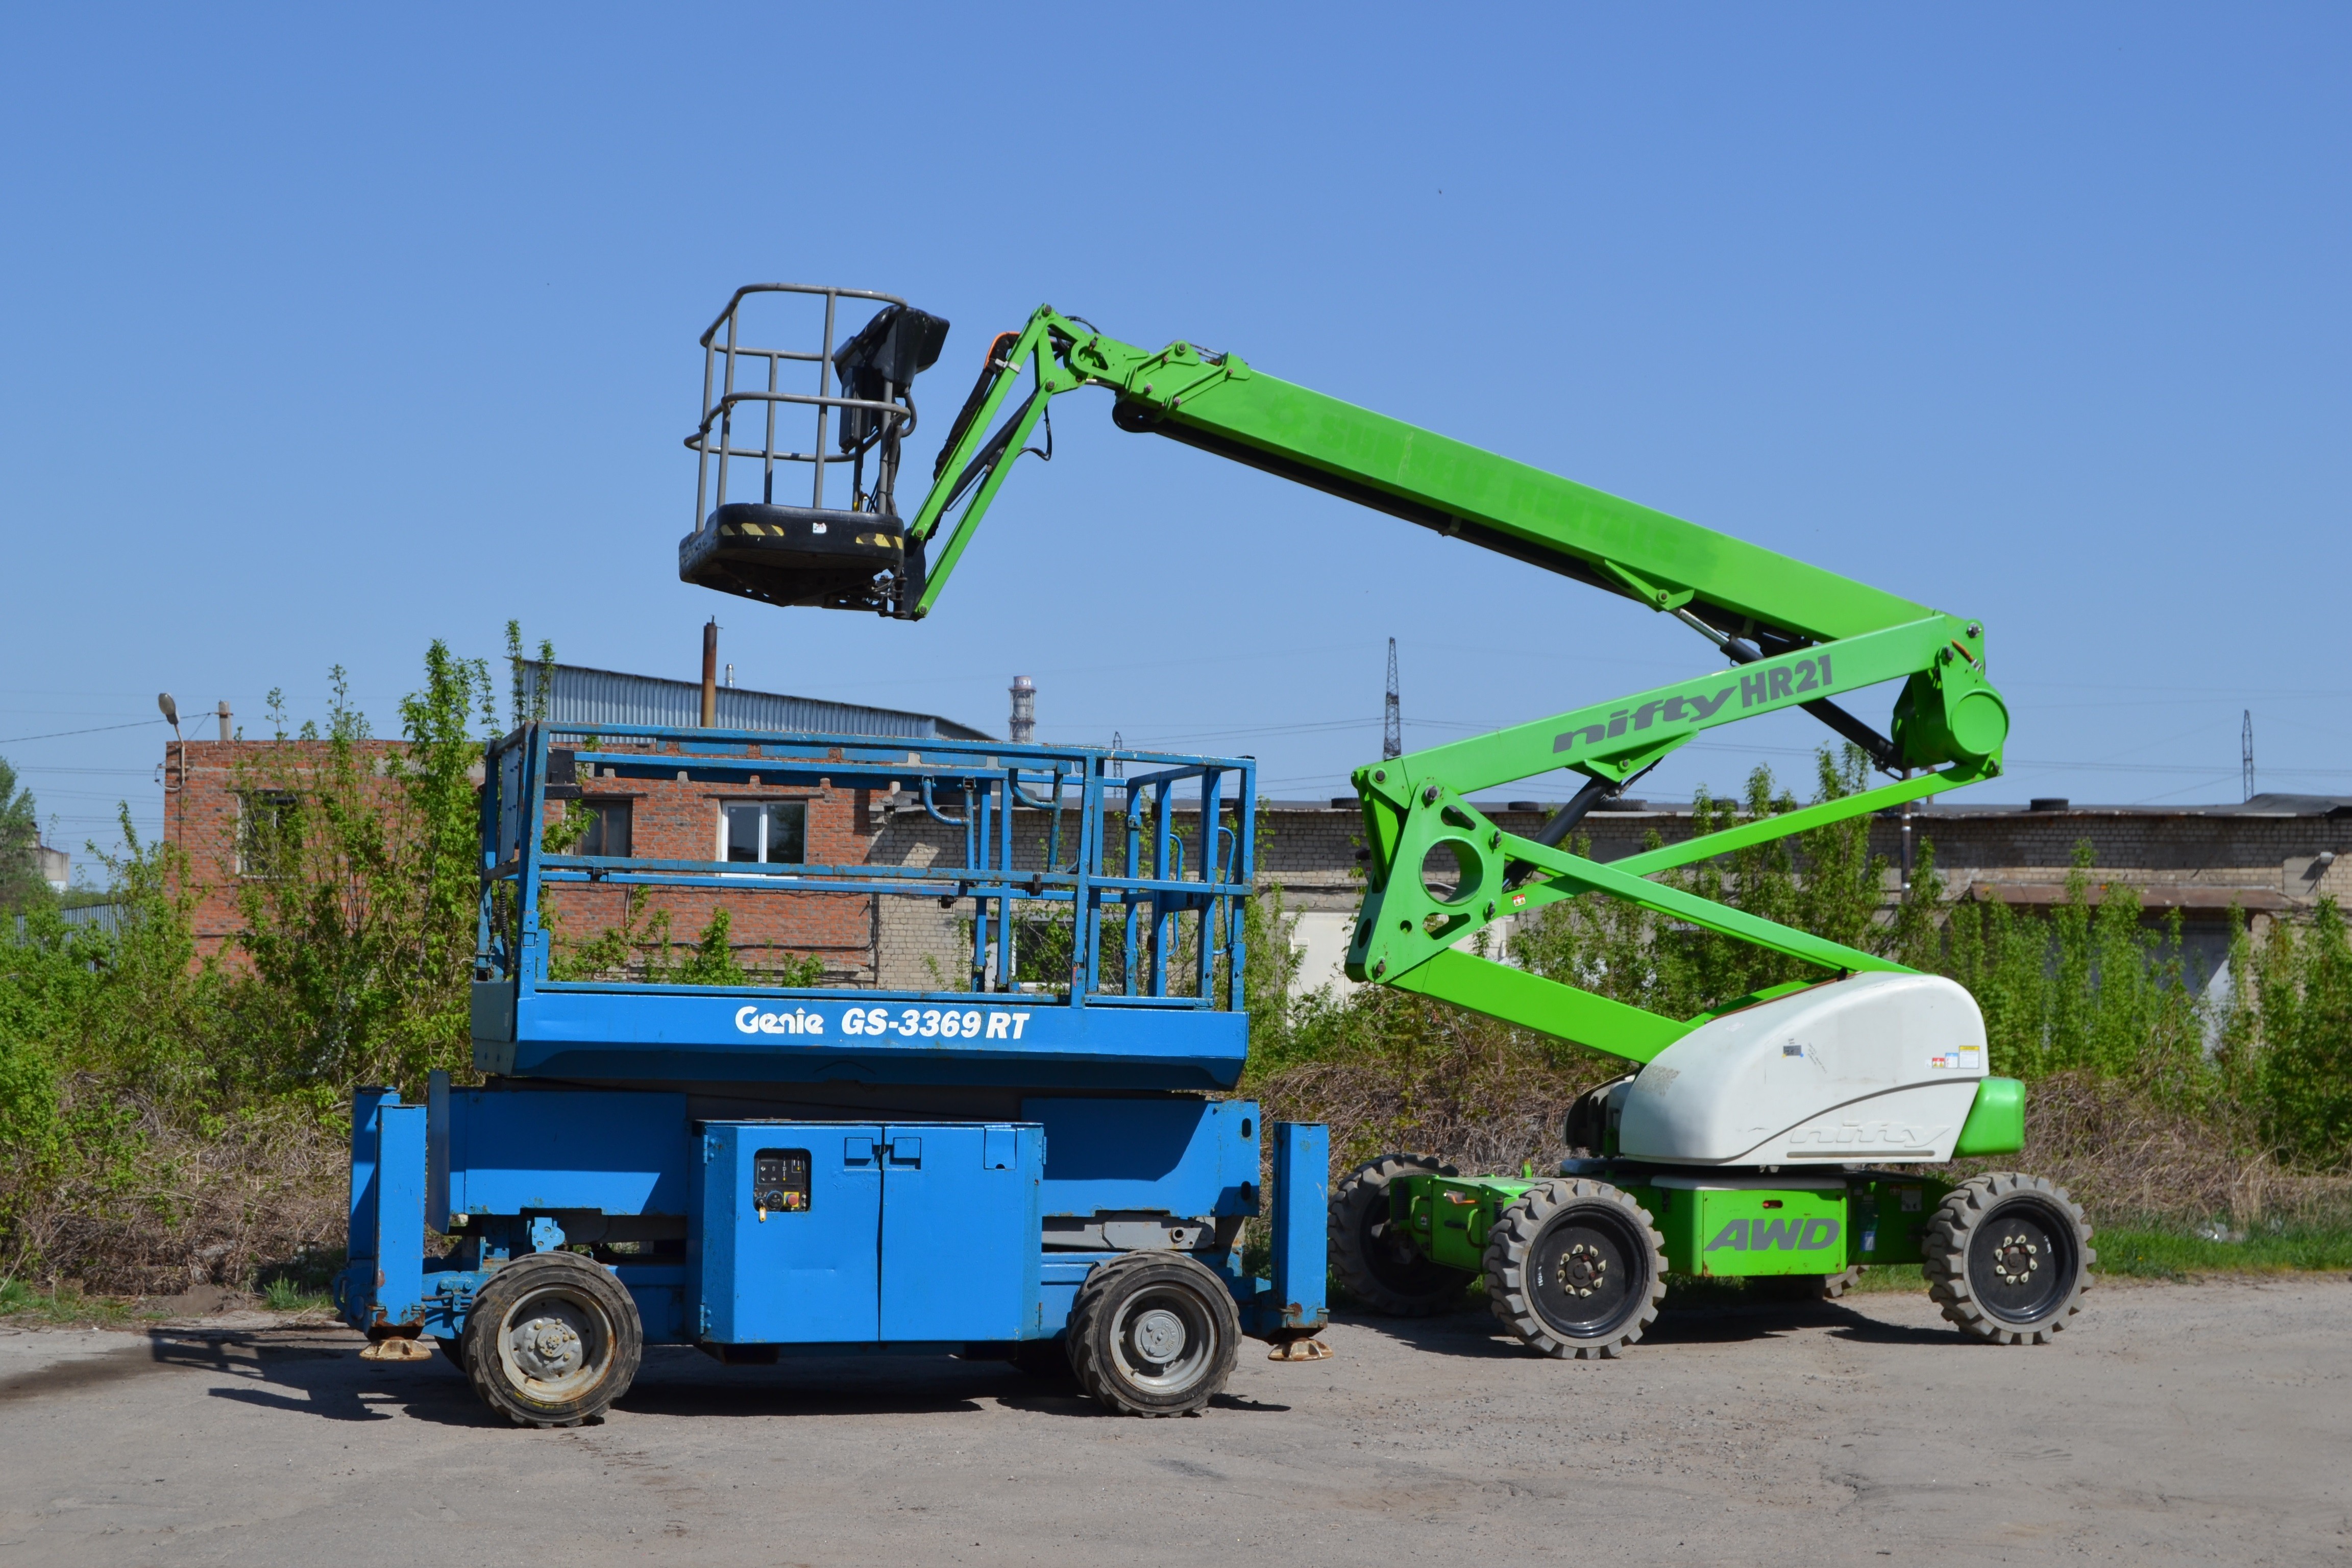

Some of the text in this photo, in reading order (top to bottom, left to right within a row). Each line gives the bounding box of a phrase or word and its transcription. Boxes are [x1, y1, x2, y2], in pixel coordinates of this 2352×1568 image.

[1553, 654, 1833, 753] nifty HR21
[735, 1006, 1030, 1040] Genie GS-3369 RT
[1790, 1120, 1952, 1148] nifty
[1704, 1218, 1841, 1252] AWD
